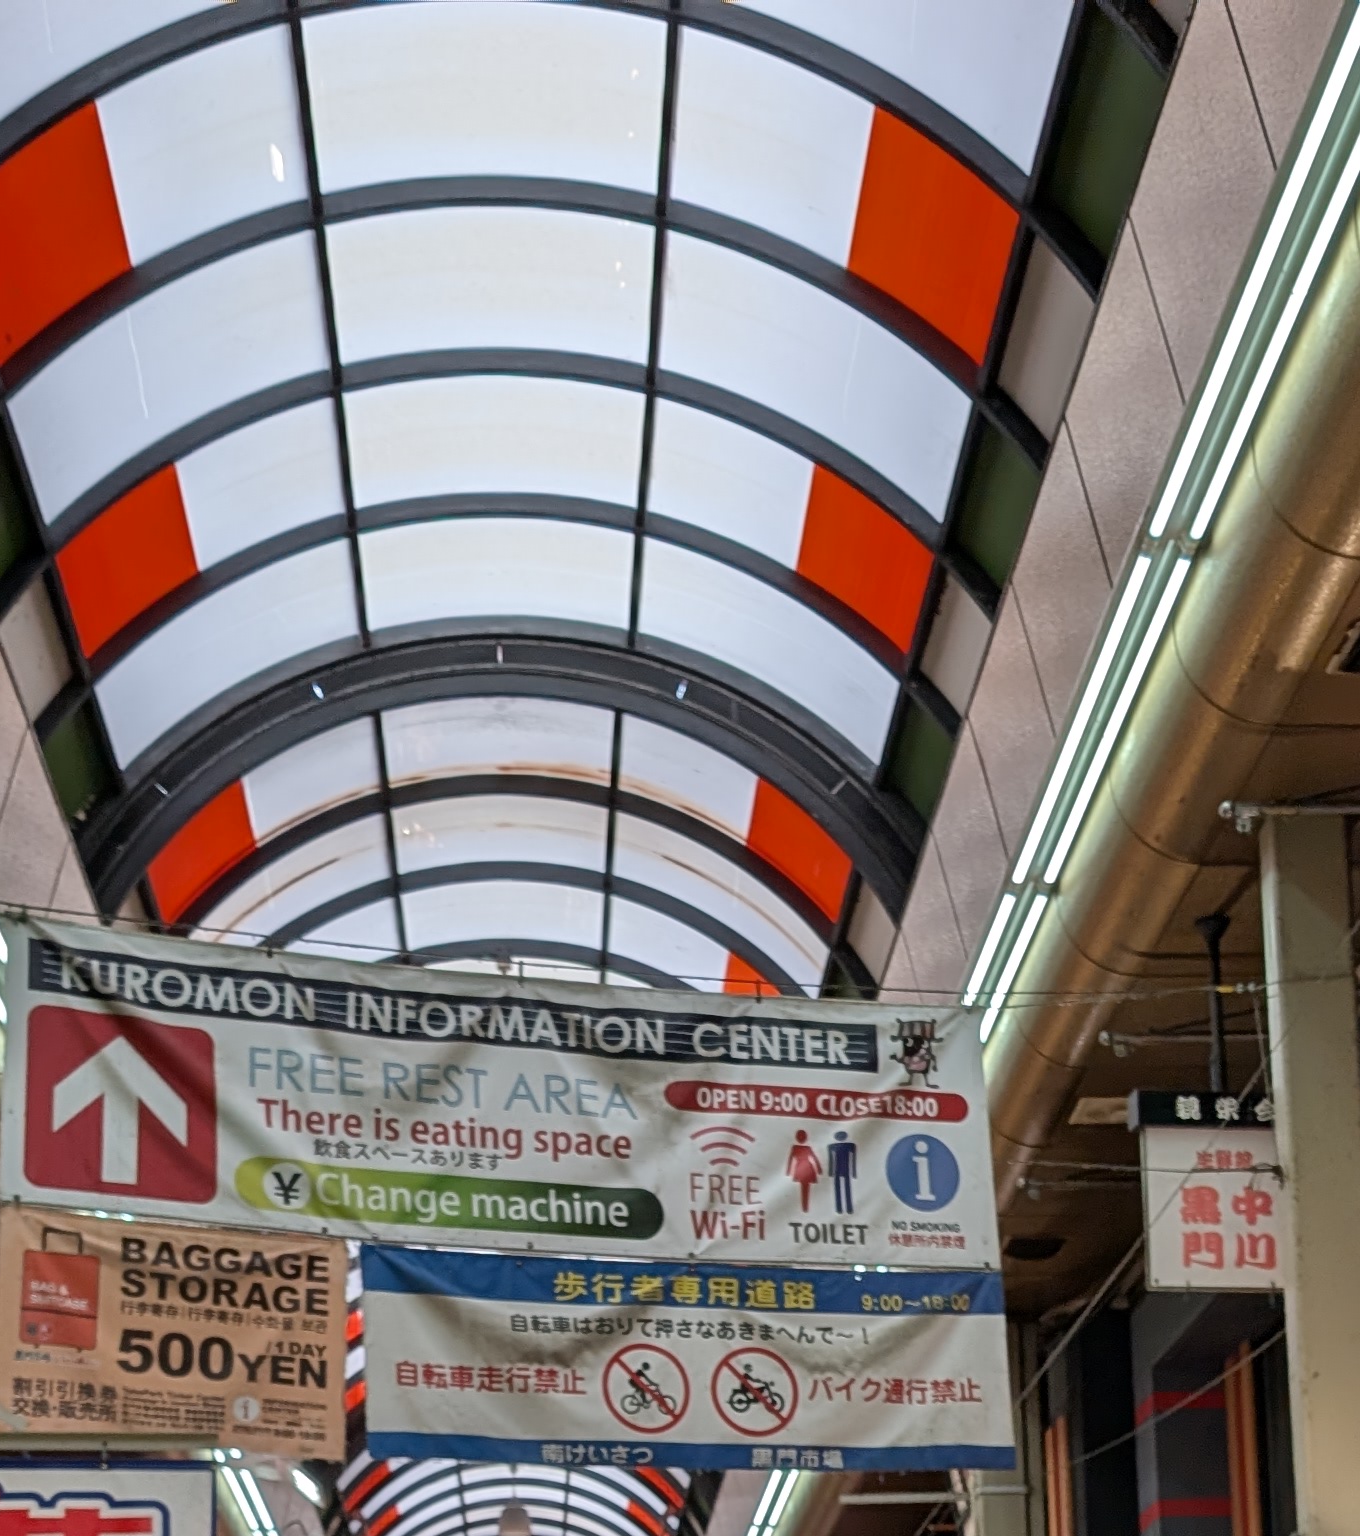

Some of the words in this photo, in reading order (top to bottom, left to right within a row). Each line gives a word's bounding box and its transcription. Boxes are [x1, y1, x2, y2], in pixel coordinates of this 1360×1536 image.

[62, 957, 316, 1022] KUROMON
[346, 991, 665, 1056] INFORMATION
[693, 1023, 850, 1065] CENTER
[248, 1048, 362, 1096] FREE
[383, 1063, 488, 1108] REST
[503, 1073, 638, 1120] AREA
[696, 1087, 756, 1111] OPEN
[761, 1090, 807, 1113] 9:00
[258, 1099, 362, 1139] There
[374, 1109, 398, 1142] is
[411, 1116, 523, 1159] eating
[534, 1129, 632, 1161] space
[313, 1138, 502, 1170] 飲食スペースあります
[316, 1172, 461, 1218] Change
[472, 1187, 629, 1228] machine
[690, 1173, 762, 1205] FREE
[690, 1209, 766, 1241] Wi-Fi
[789, 1222, 869, 1245] TOILET
[891, 1220, 907, 1231] NO
[910, 1222, 960, 1233] SMOKING
[121, 1237, 330, 1284] BAGGAGE
[121, 1268, 329, 1317] STORAGE
[553, 1271, 816, 1311] 歩行者専用道路
[117, 1328, 234, 1382] 500
[238, 1353, 327, 1389] YEN
[289, 1342, 327, 1357] DAY
[396, 1361, 587, 1396] 自転車走行禁止
[808, 1376, 982, 1405] バイク通行禁止
